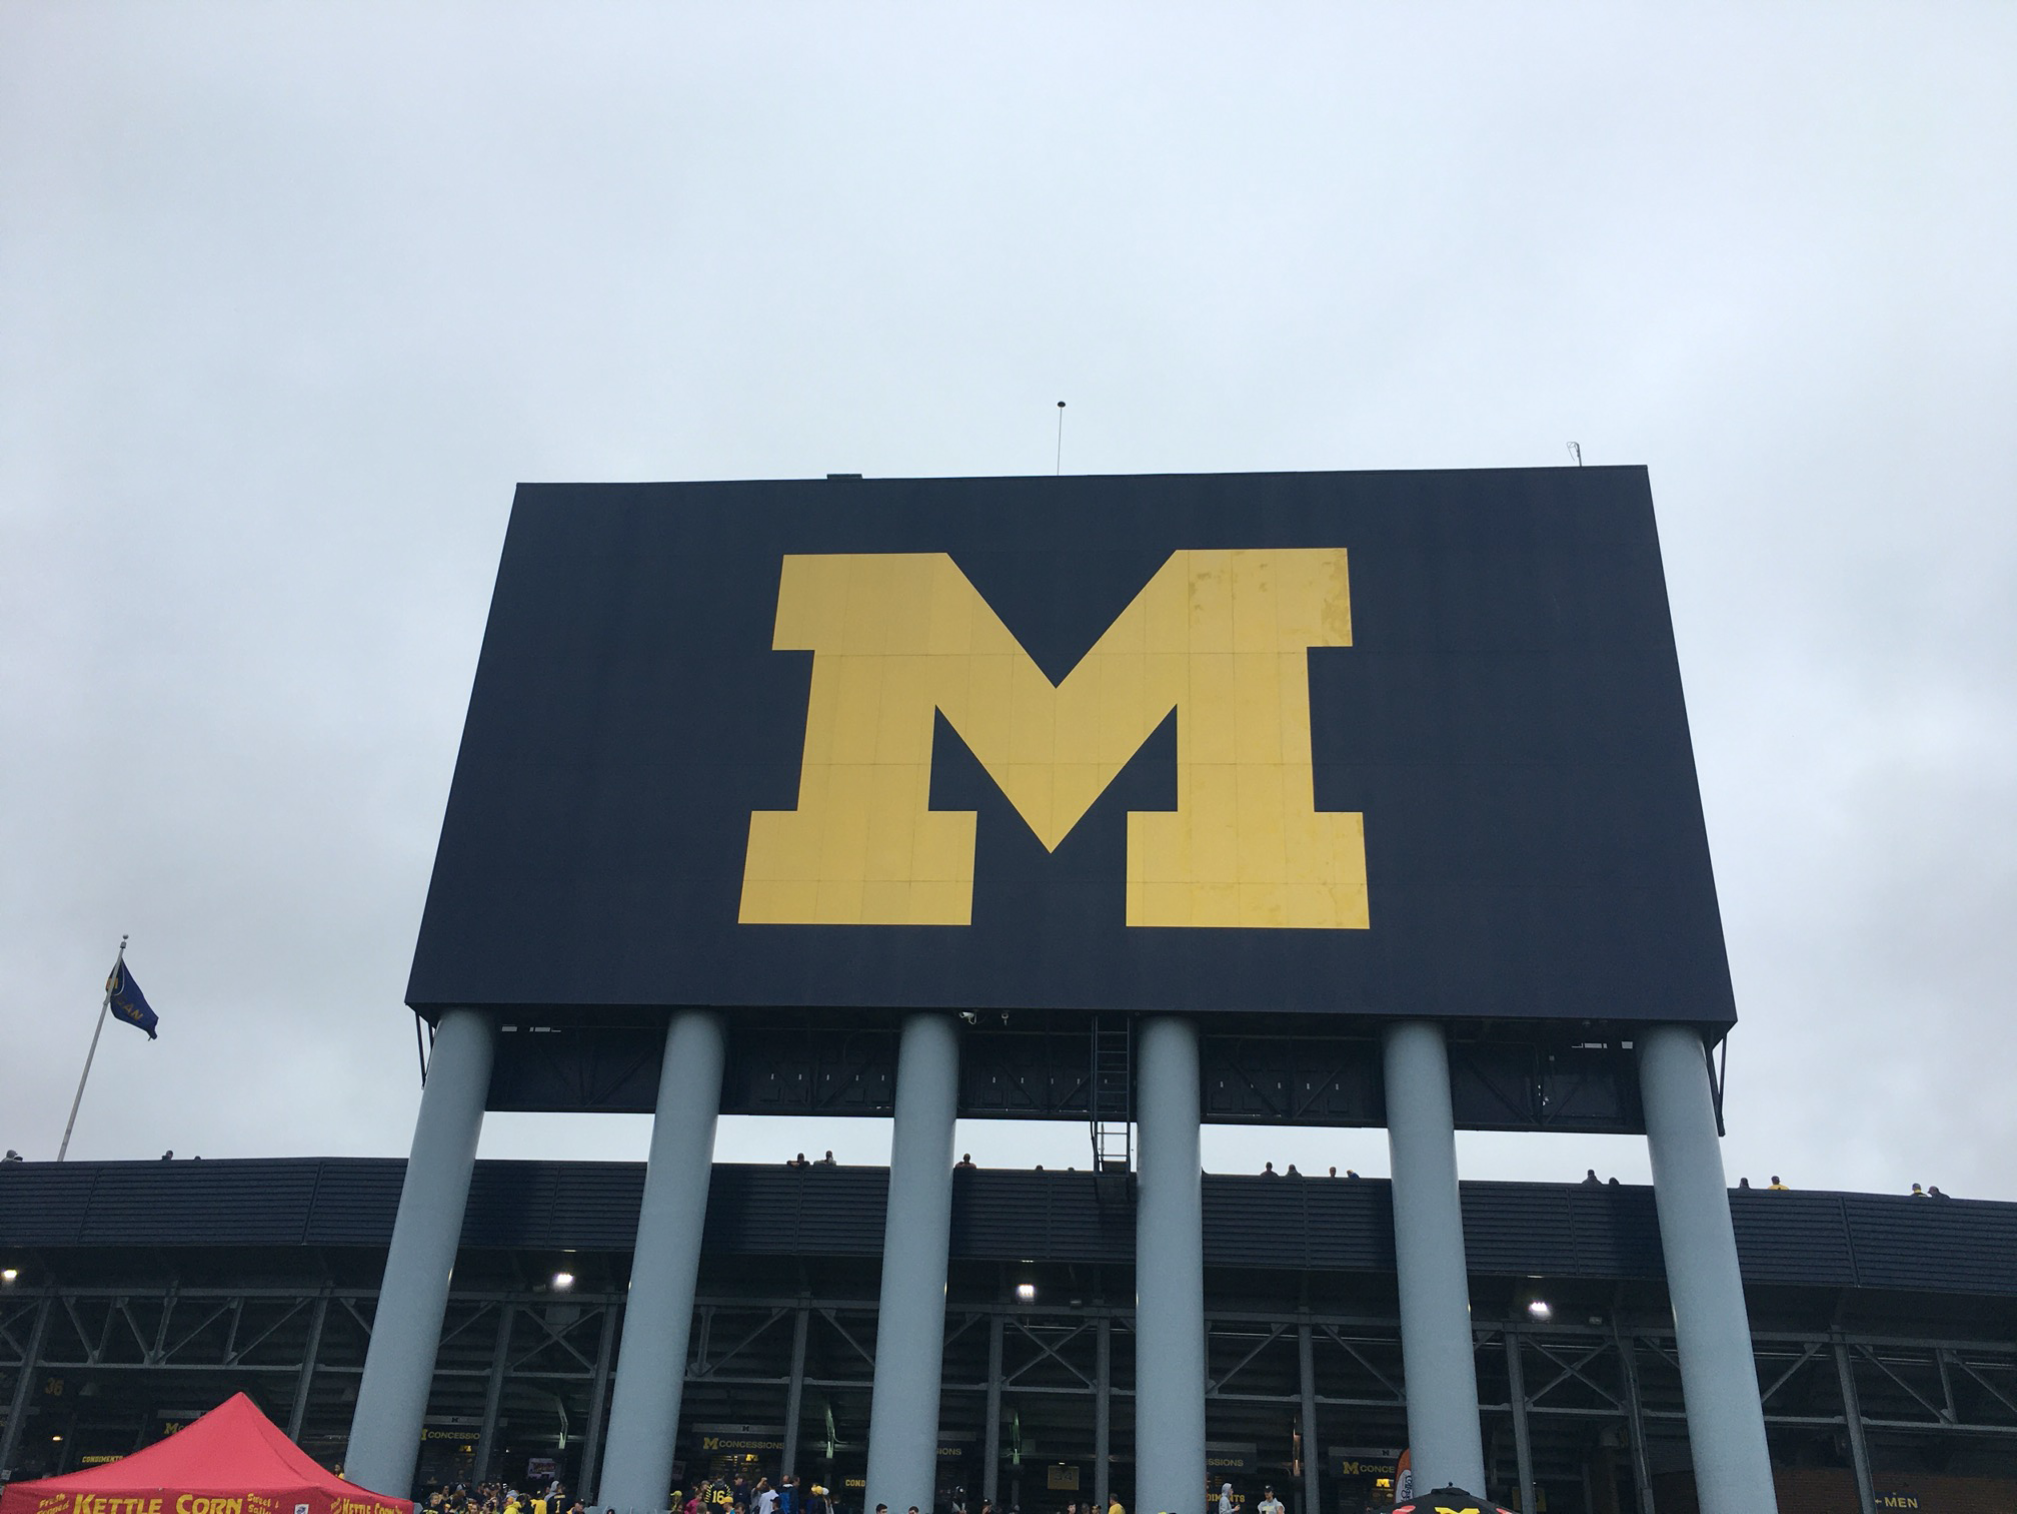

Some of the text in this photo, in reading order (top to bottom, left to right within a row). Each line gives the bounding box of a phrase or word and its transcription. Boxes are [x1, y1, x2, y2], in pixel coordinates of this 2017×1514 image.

[738, 548, 1370, 929] M
[703, 1437, 784, 1450] M CONCESSIONS
[1343, 1462, 1359, 1474] M
[712, 1490, 726, 1504] 16
[1884, 1497, 1918, 1508] MEN
[74, 1494, 243, 1514] KETTLE CORN
